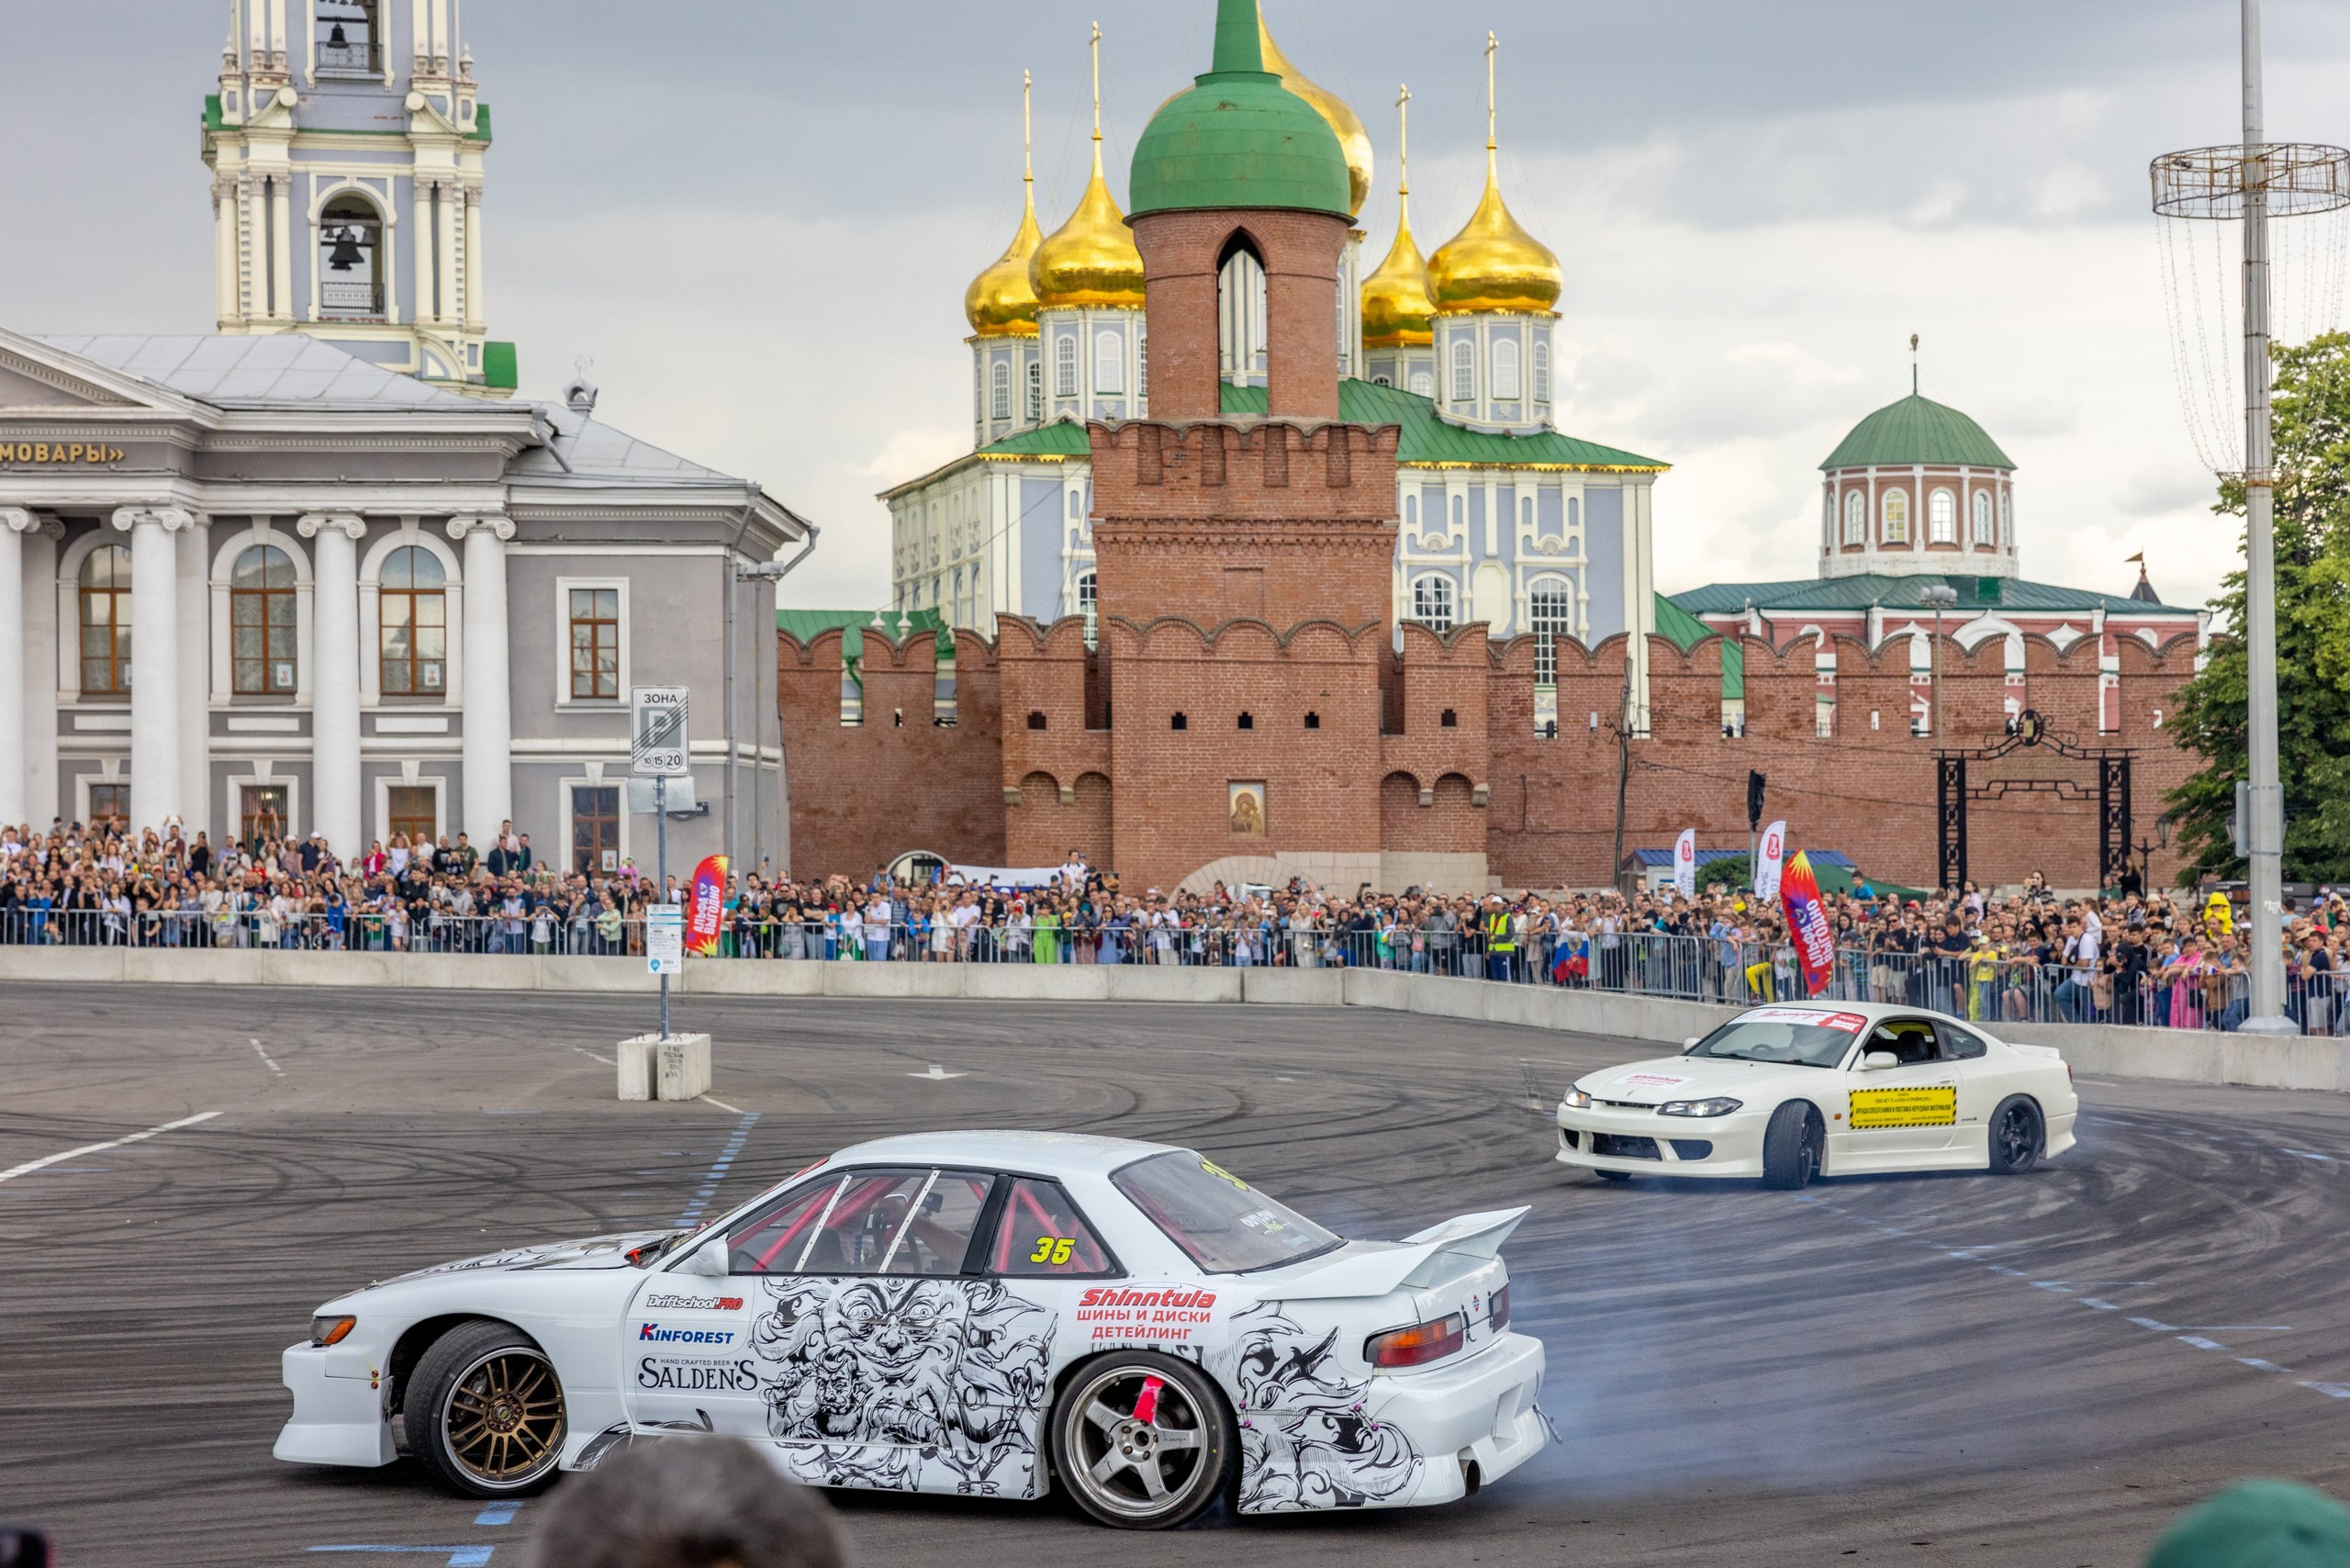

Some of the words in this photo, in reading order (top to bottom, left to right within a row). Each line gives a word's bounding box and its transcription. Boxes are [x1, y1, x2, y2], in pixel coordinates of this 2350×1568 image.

[644, 693, 677, 704] ЗОНА
[655, 756, 664, 766] 15
[666, 755, 681, 766] 20
[693, 897, 710, 934] АЛЬФА
[703, 885, 721, 935] ВЫГОДНО
[1806, 899, 1834, 964] ВЫГОДНО
[1799, 924, 1825, 969] АЛЬФА
[1029, 1236, 1077, 1266] 35
[1079, 1288, 1217, 1308] Shinntula
[1077, 1310, 1130, 1321] ШИНЫ
[1136, 1310, 1147, 1321] И
[1152, 1310, 1211, 1323] ДИСКИ
[639, 1323, 734, 1344] KINFOREST
[1091, 1324, 1192, 1340] ДЕТЕЙЛИНГ
[638, 1357, 758, 1391] SALDEN'S
